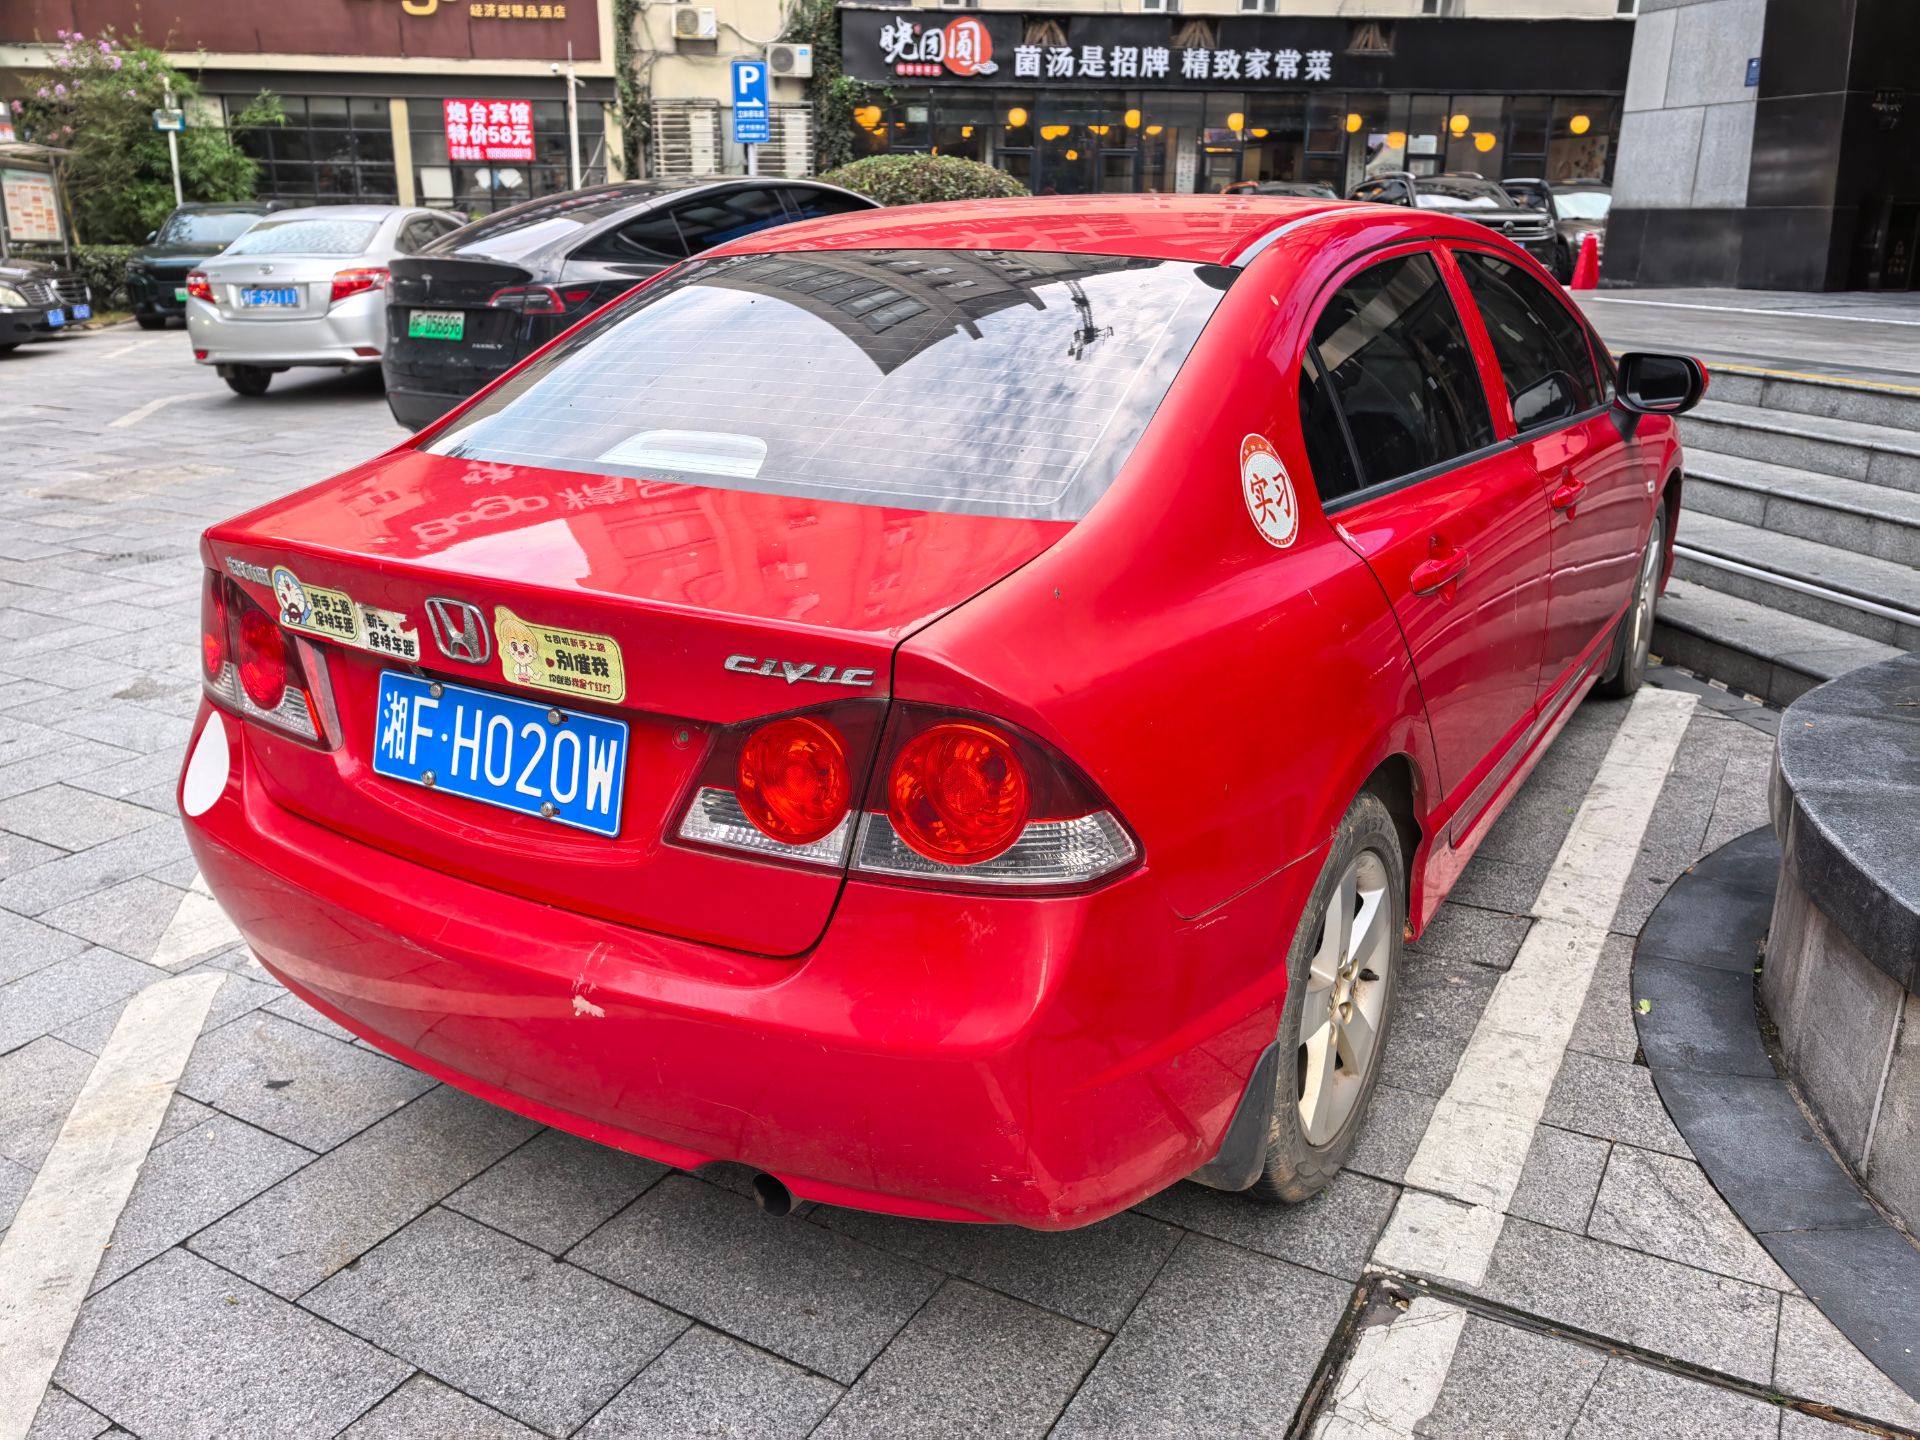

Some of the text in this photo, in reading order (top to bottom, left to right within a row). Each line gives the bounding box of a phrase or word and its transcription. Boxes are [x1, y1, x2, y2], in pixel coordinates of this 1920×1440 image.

[469, 4, 567, 18] 经济型精品酒店
[1014, 45, 1334, 81] 菌汤是招牌 精致家常菜
[739, 66, 760, 94] P
[447, 123, 532, 145] 特价58元
[1250, 473, 1291, 524] 实习
[310, 593, 351, 616] 新手上路
[315, 611, 354, 634] 保持车距
[369, 631, 415, 657] 保持车距
[544, 633, 606, 652] 女司机新手上路
[555, 649, 609, 678] 别催我
[724, 654, 875, 686] CIVIC
[549, 673, 611, 694] 你就当我是个红灯
